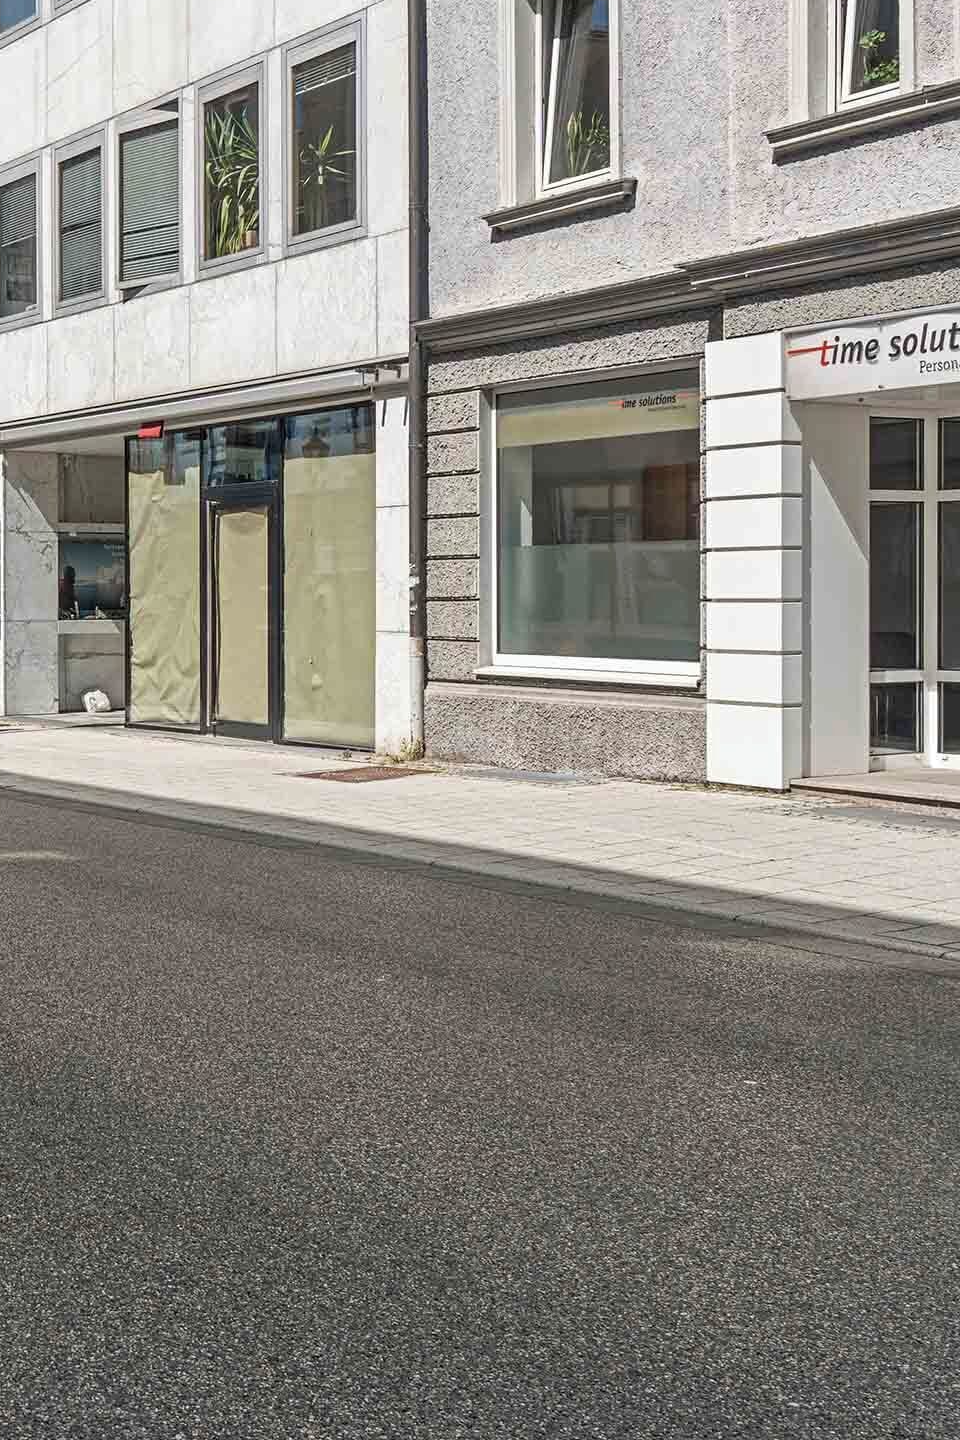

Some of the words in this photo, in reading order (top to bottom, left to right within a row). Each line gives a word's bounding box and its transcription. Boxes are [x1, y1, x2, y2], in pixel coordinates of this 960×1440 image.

[818, 335, 880, 367] time
[919, 359, 960, 374] Person
[639, 394, 677, 408] solutions
